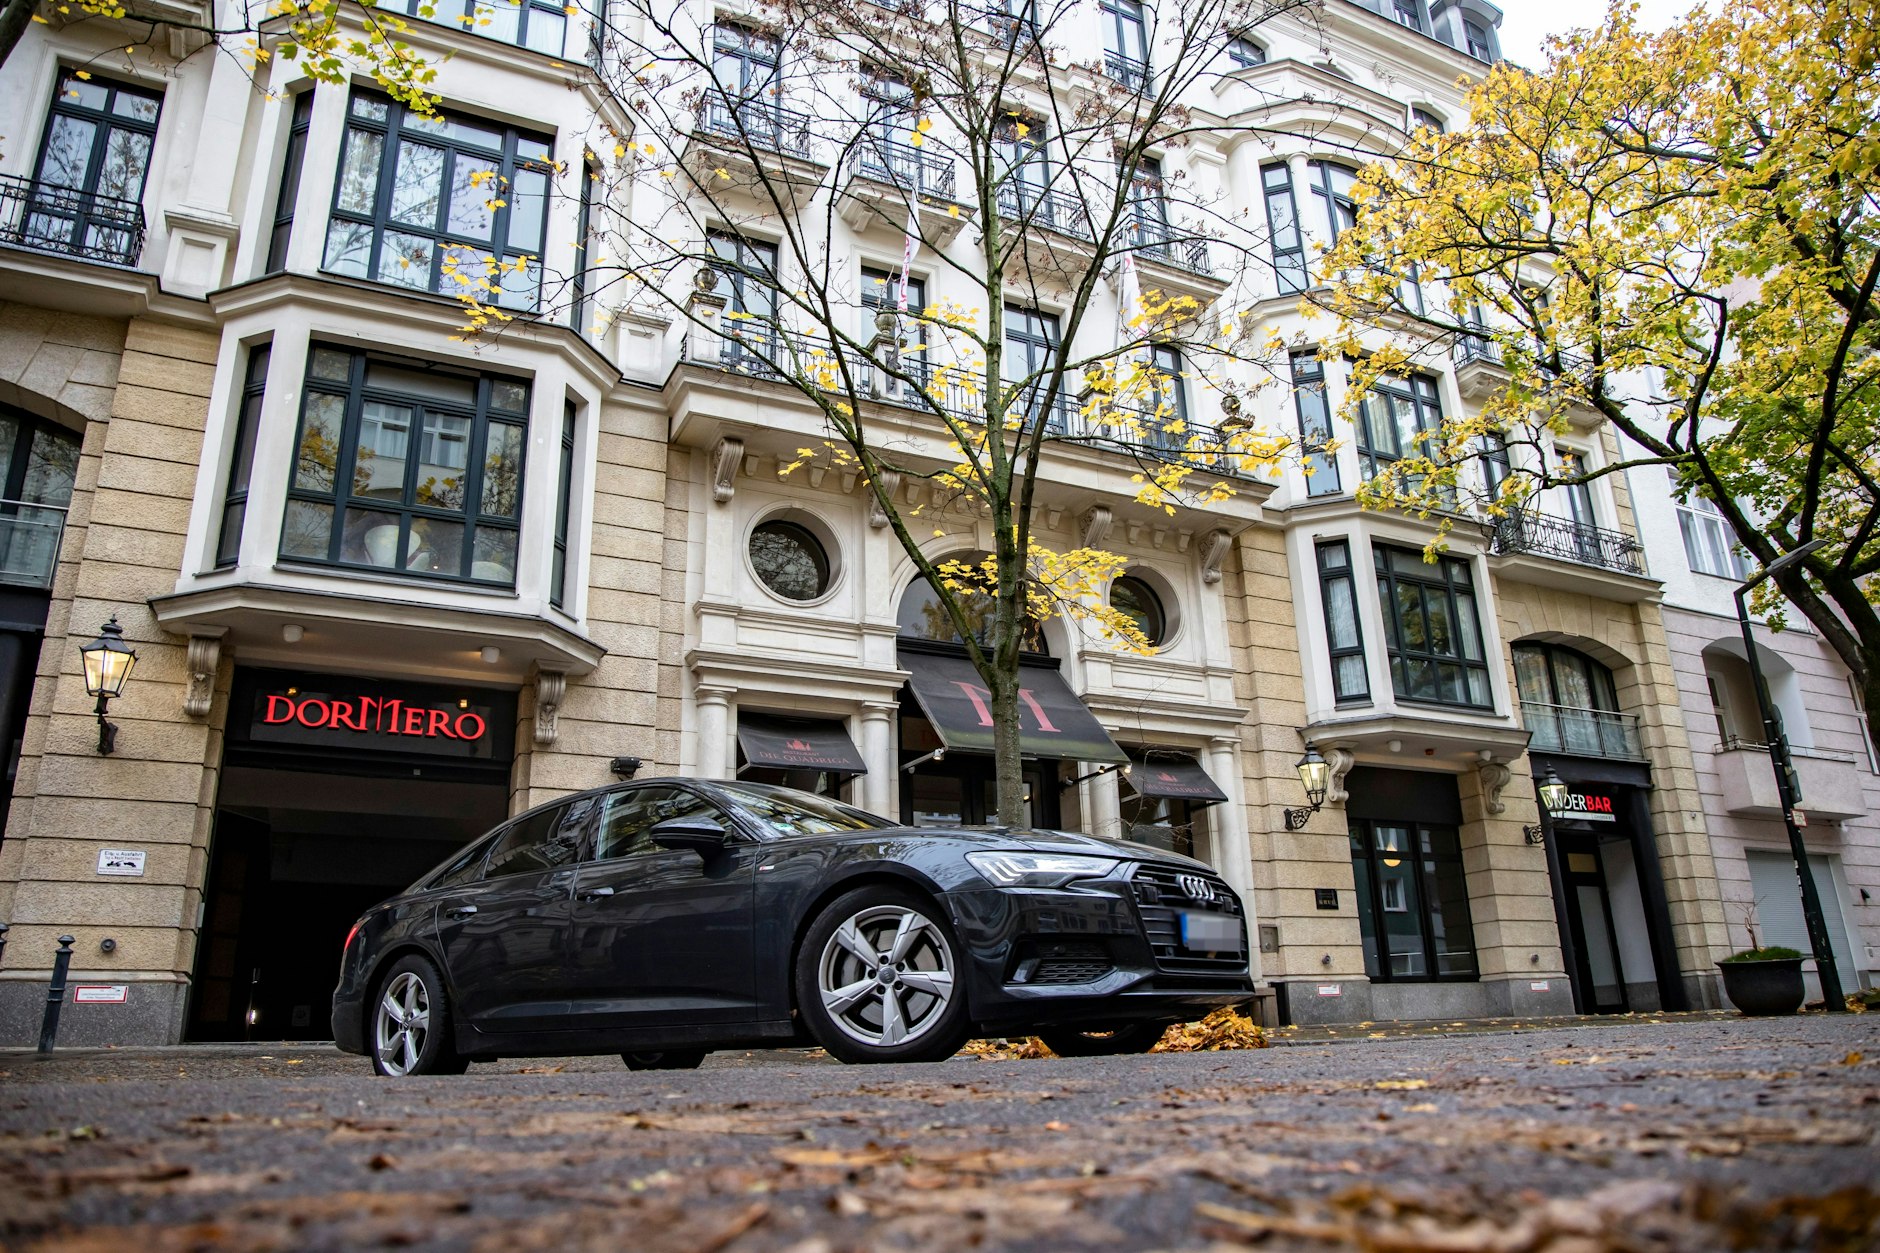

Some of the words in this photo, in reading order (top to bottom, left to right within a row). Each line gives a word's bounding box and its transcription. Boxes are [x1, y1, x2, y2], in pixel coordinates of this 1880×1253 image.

[263, 694, 486, 740] DORMERO
[760, 751, 781, 760] DIE
[783, 754, 850, 764] QUADRIGA
